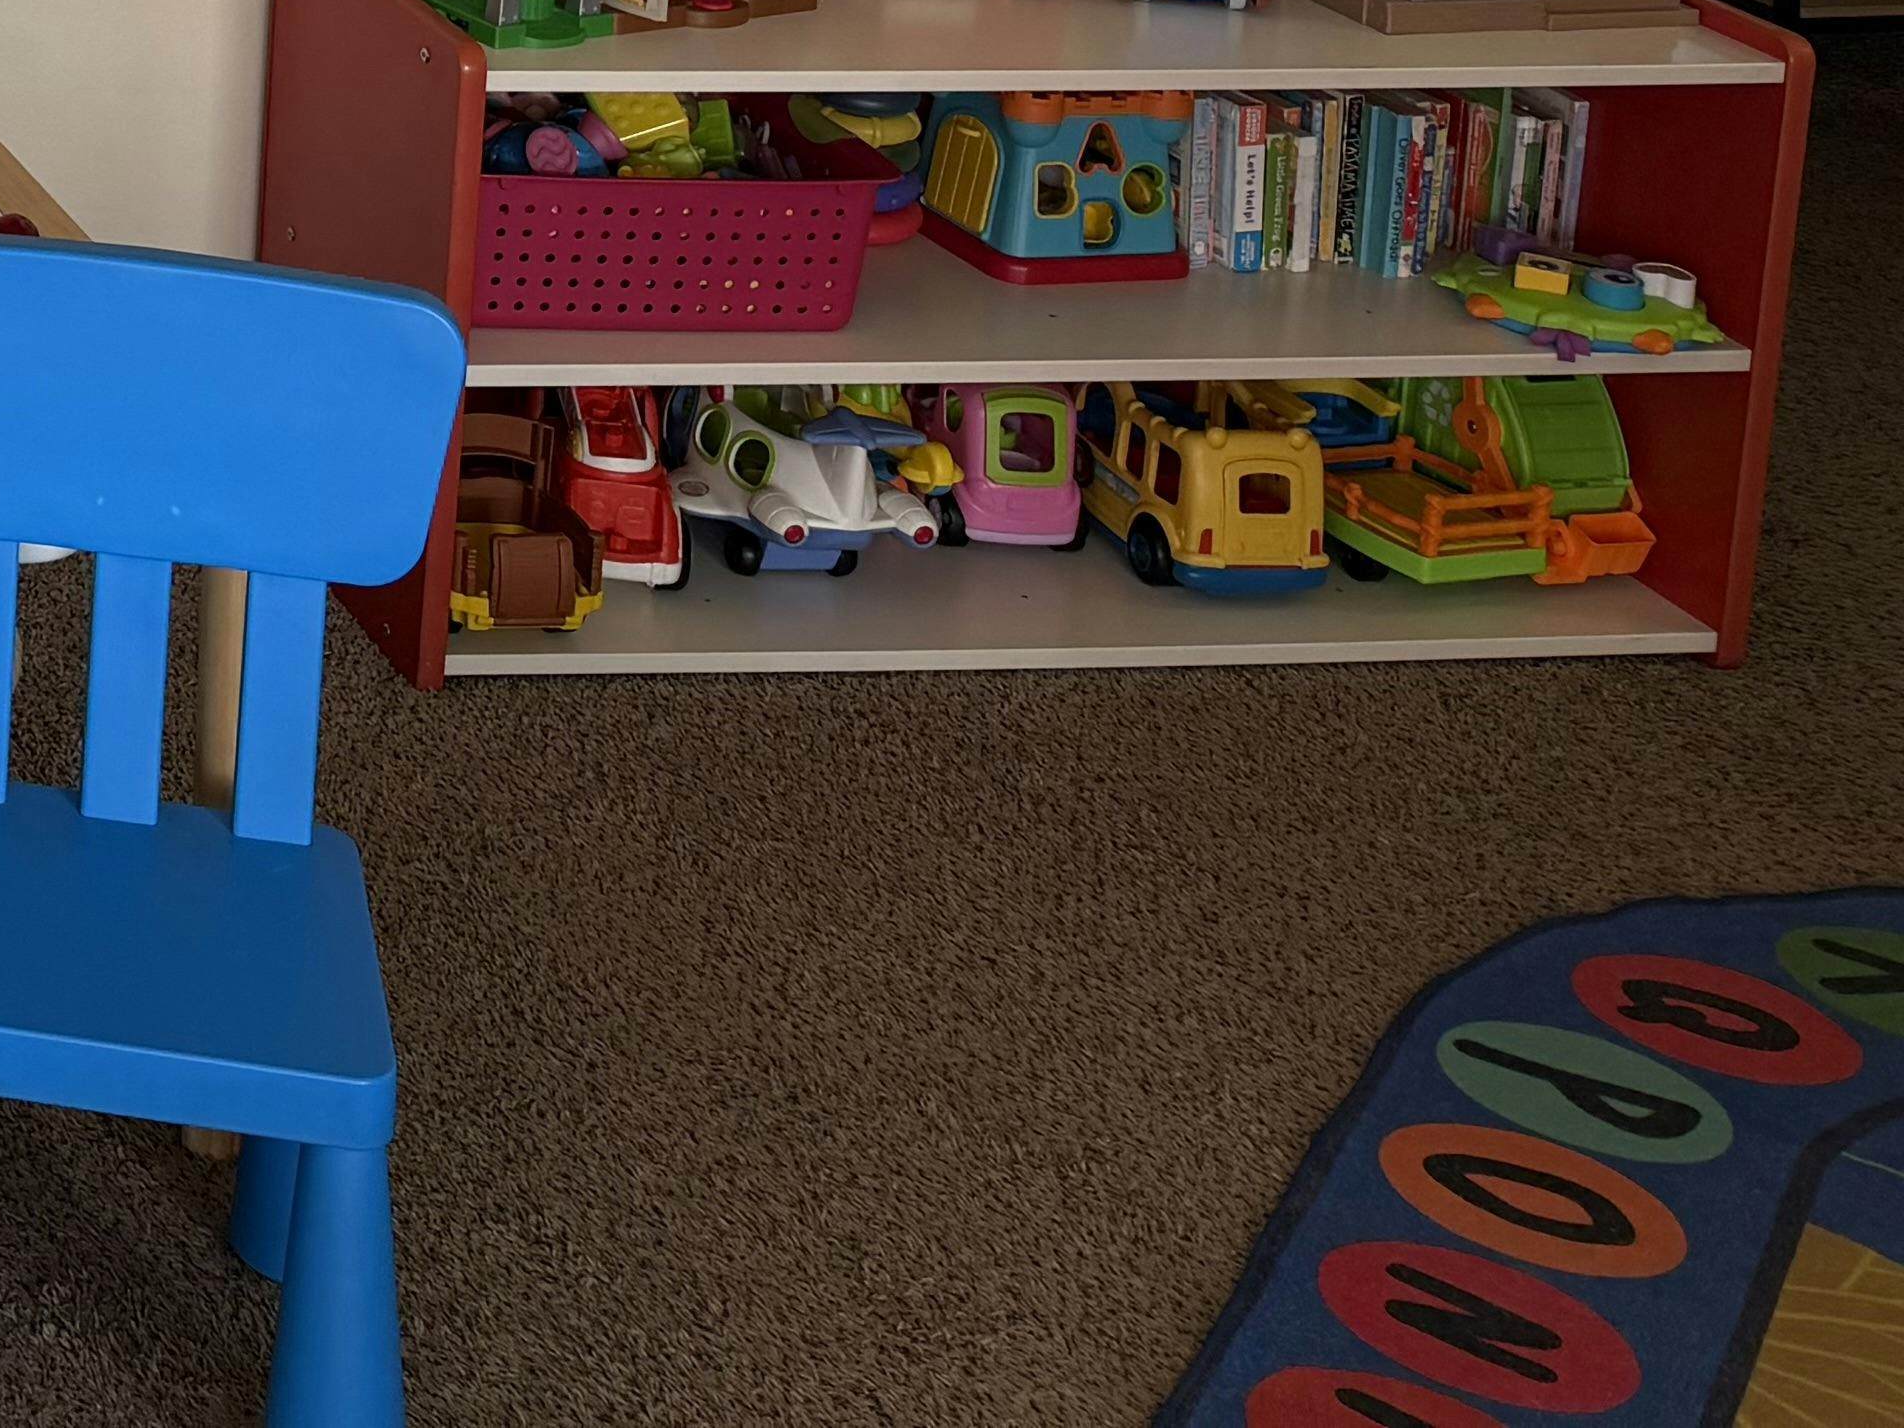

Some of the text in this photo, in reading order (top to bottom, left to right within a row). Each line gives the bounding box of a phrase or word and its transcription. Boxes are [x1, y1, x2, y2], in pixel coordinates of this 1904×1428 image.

[1246, 154, 1257, 187] Let's
[1398, 138, 1409, 173] Oliver
[1244, 190, 1256, 224] Help!
[1395, 175, 1407, 209] Goes
[1272, 215, 1283, 242] Frog
[1453, 1039, 1700, 1139] P
[1423, 1153, 1636, 1246] O
[1385, 1262, 1562, 1384] N
